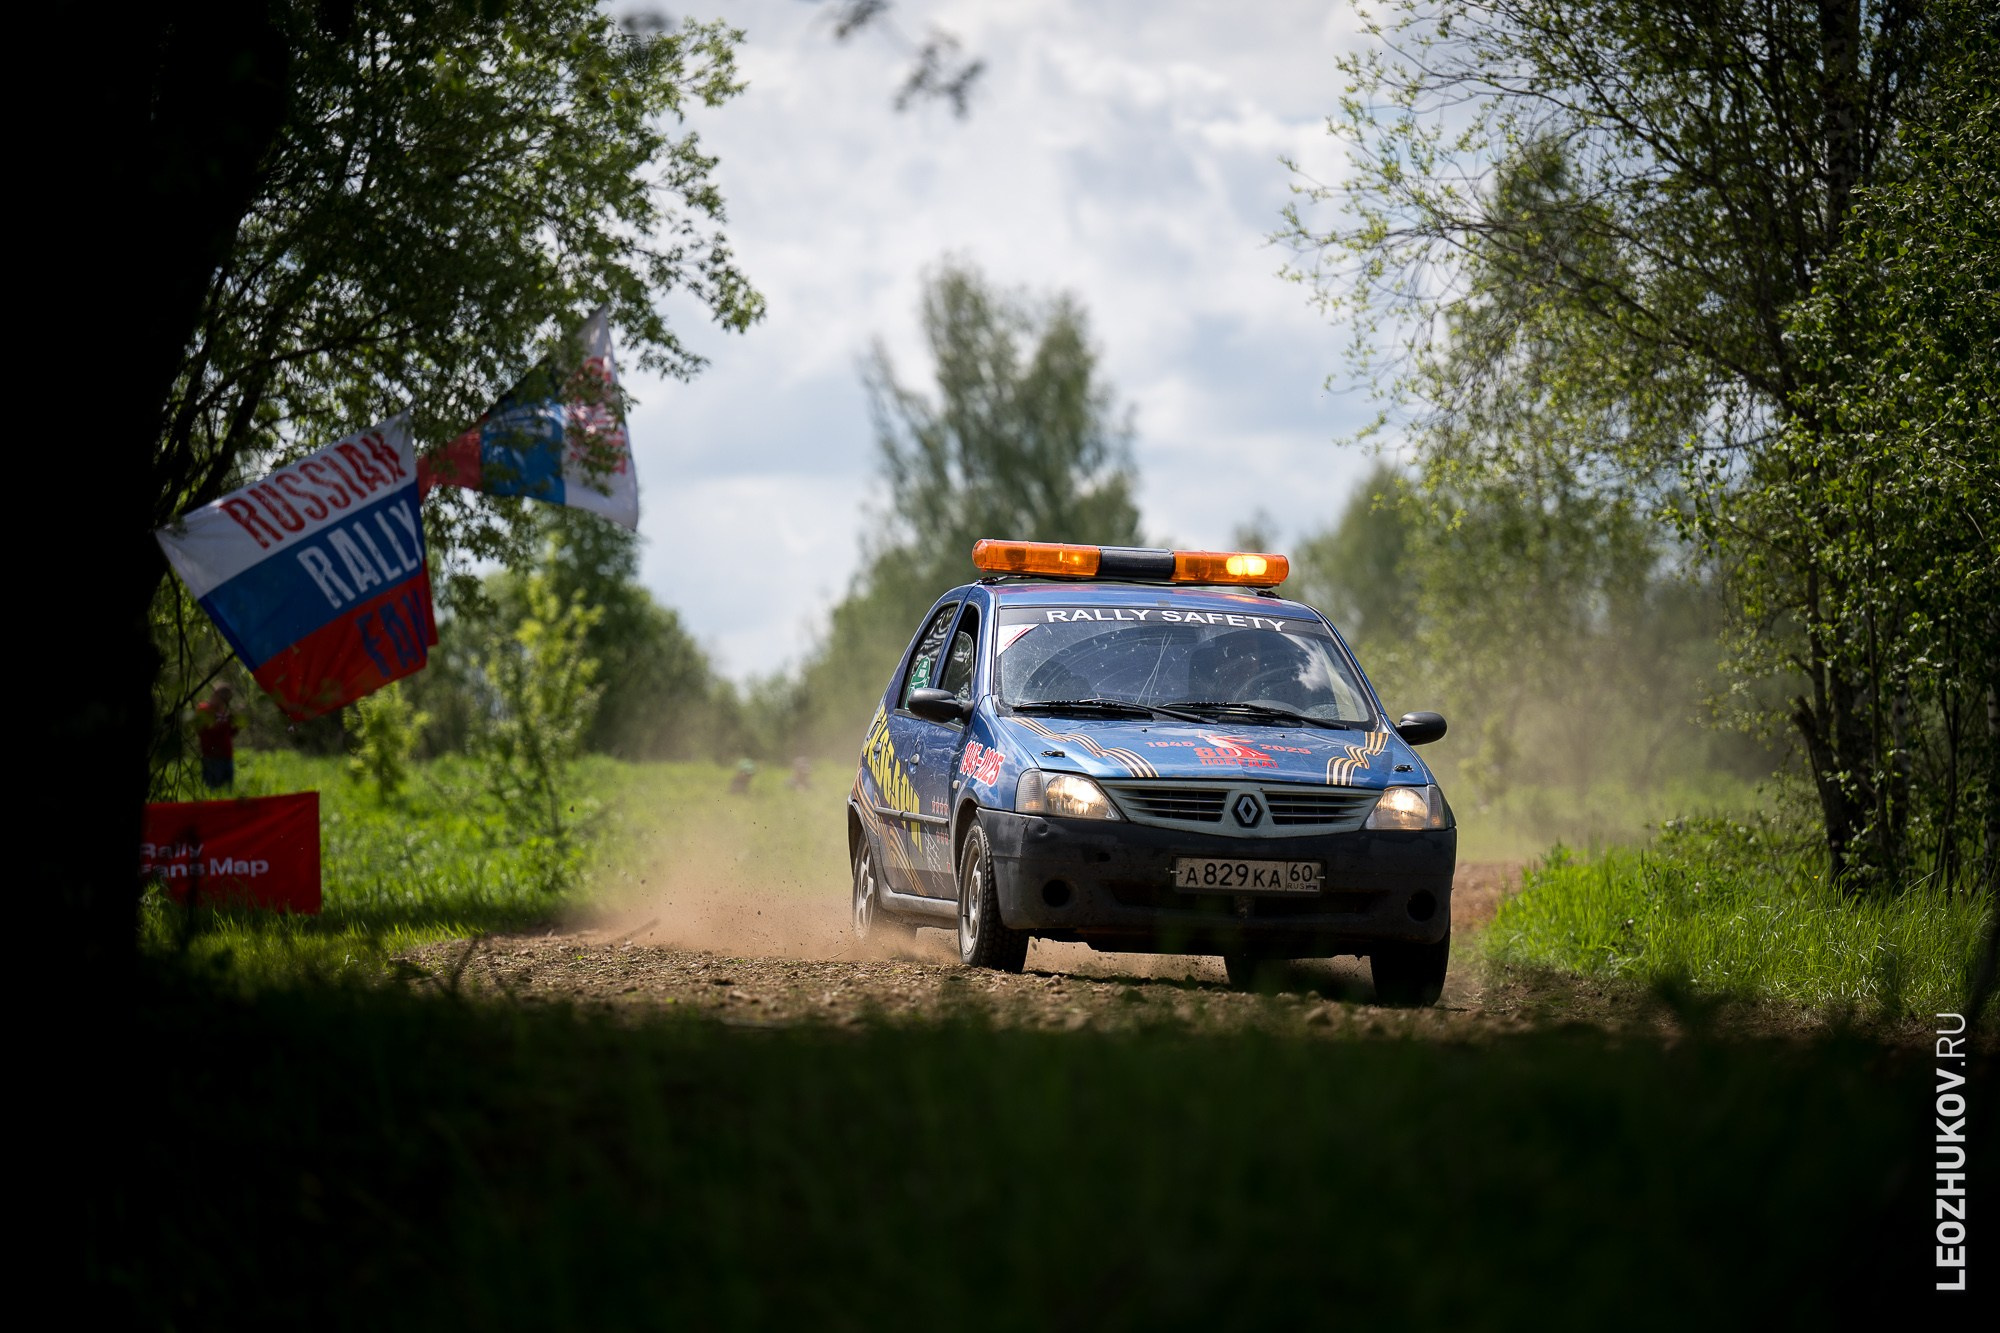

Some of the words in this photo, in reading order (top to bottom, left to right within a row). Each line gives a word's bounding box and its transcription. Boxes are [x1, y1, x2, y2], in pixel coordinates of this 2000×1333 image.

[296, 500, 424, 609] RALLY
[1046, 608, 1150, 623] RALLY
[1161, 610, 1286, 632] SAFETY
[1193, 747, 1236, 757] 80
[1259, 743, 1312, 754] 2025
[209, 855, 270, 878] Map
[1289, 863, 1313, 883] 60
